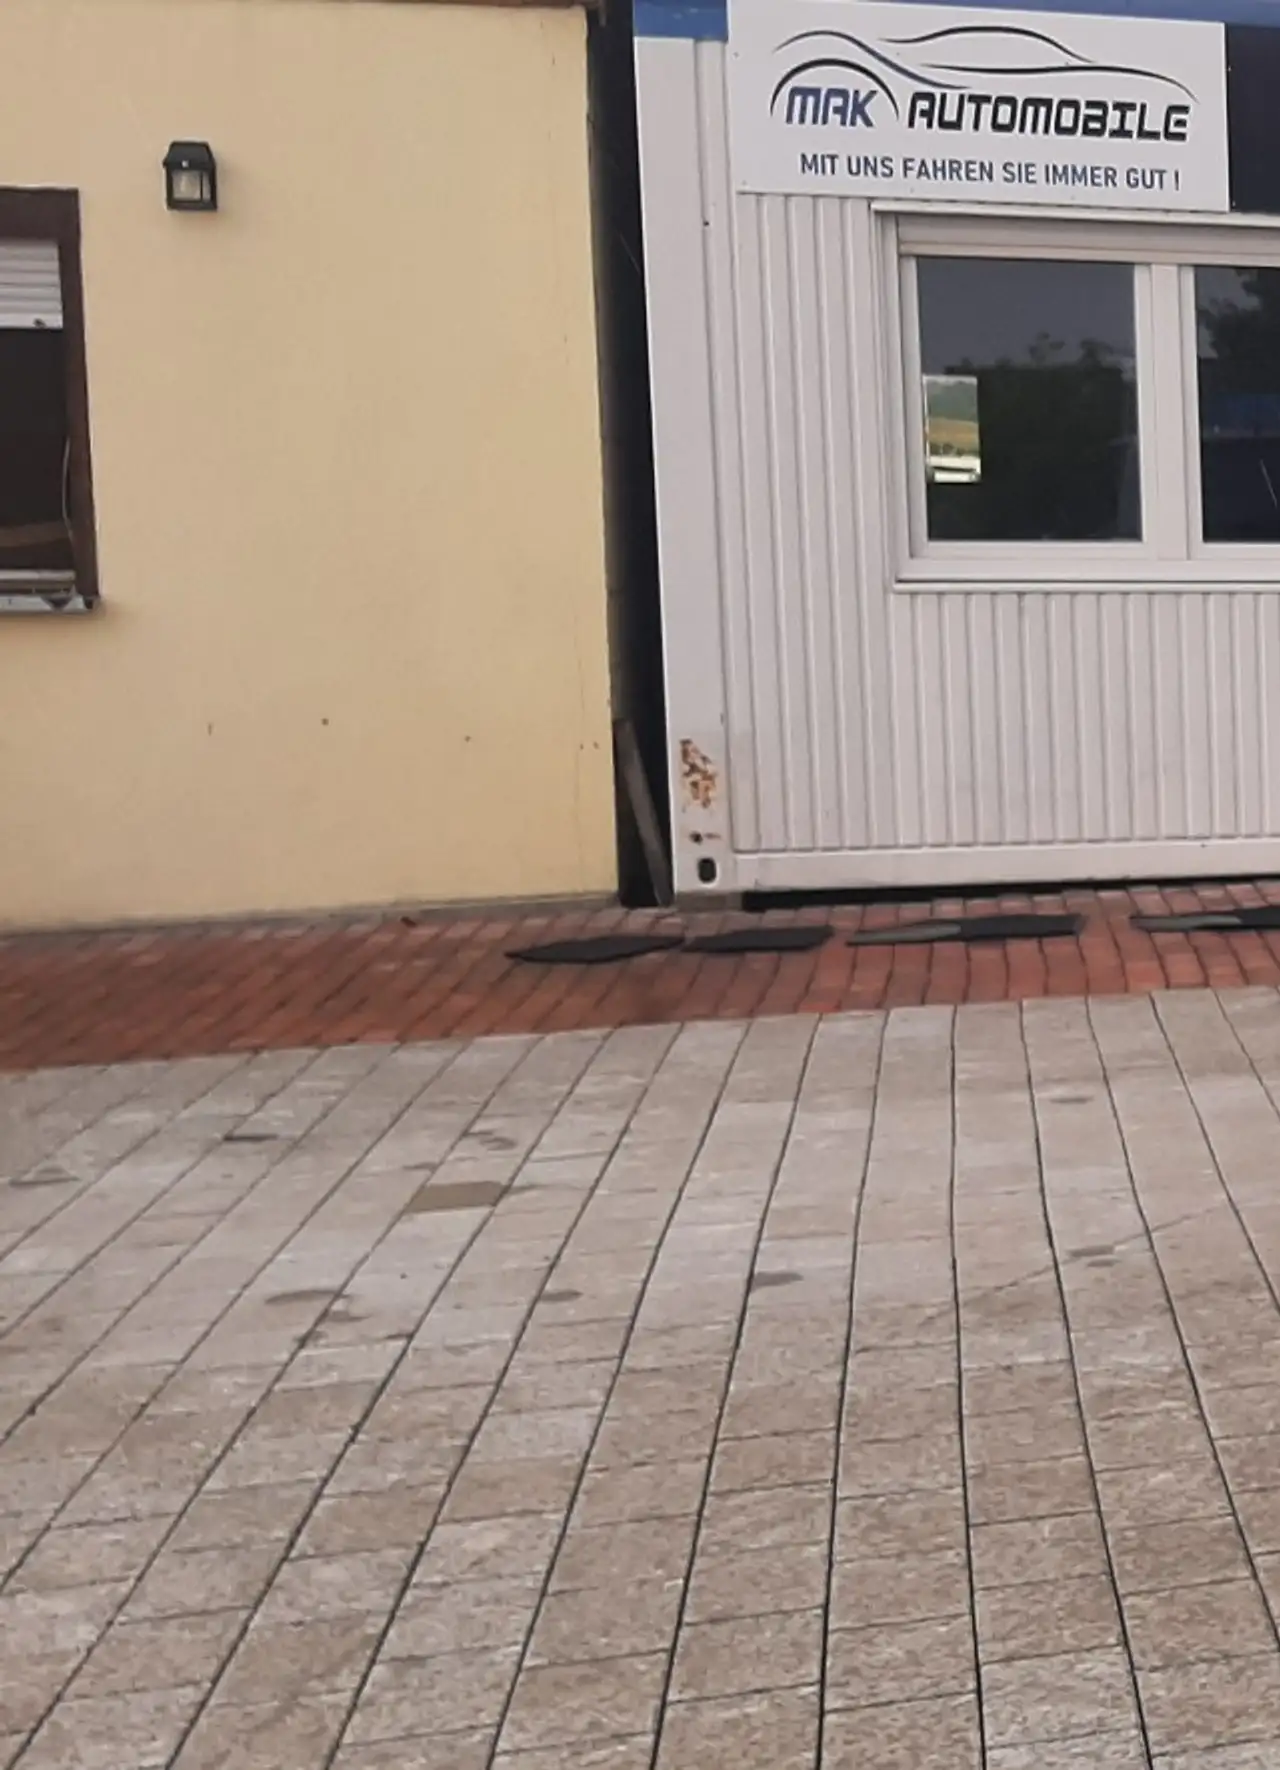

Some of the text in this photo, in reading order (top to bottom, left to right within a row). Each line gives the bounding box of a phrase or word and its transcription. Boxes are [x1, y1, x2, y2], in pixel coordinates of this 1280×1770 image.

[785, 85, 1190, 142] MAK AUTOMOBILE
[800, 152, 840, 177] MIT
[846, 156, 894, 179] UNS
[902, 158, 994, 183] FAHREN
[1002, 162, 1037, 184] SIE
[1044, 164, 1118, 188] IMMER
[1126, 168, 1167, 190] GUT
